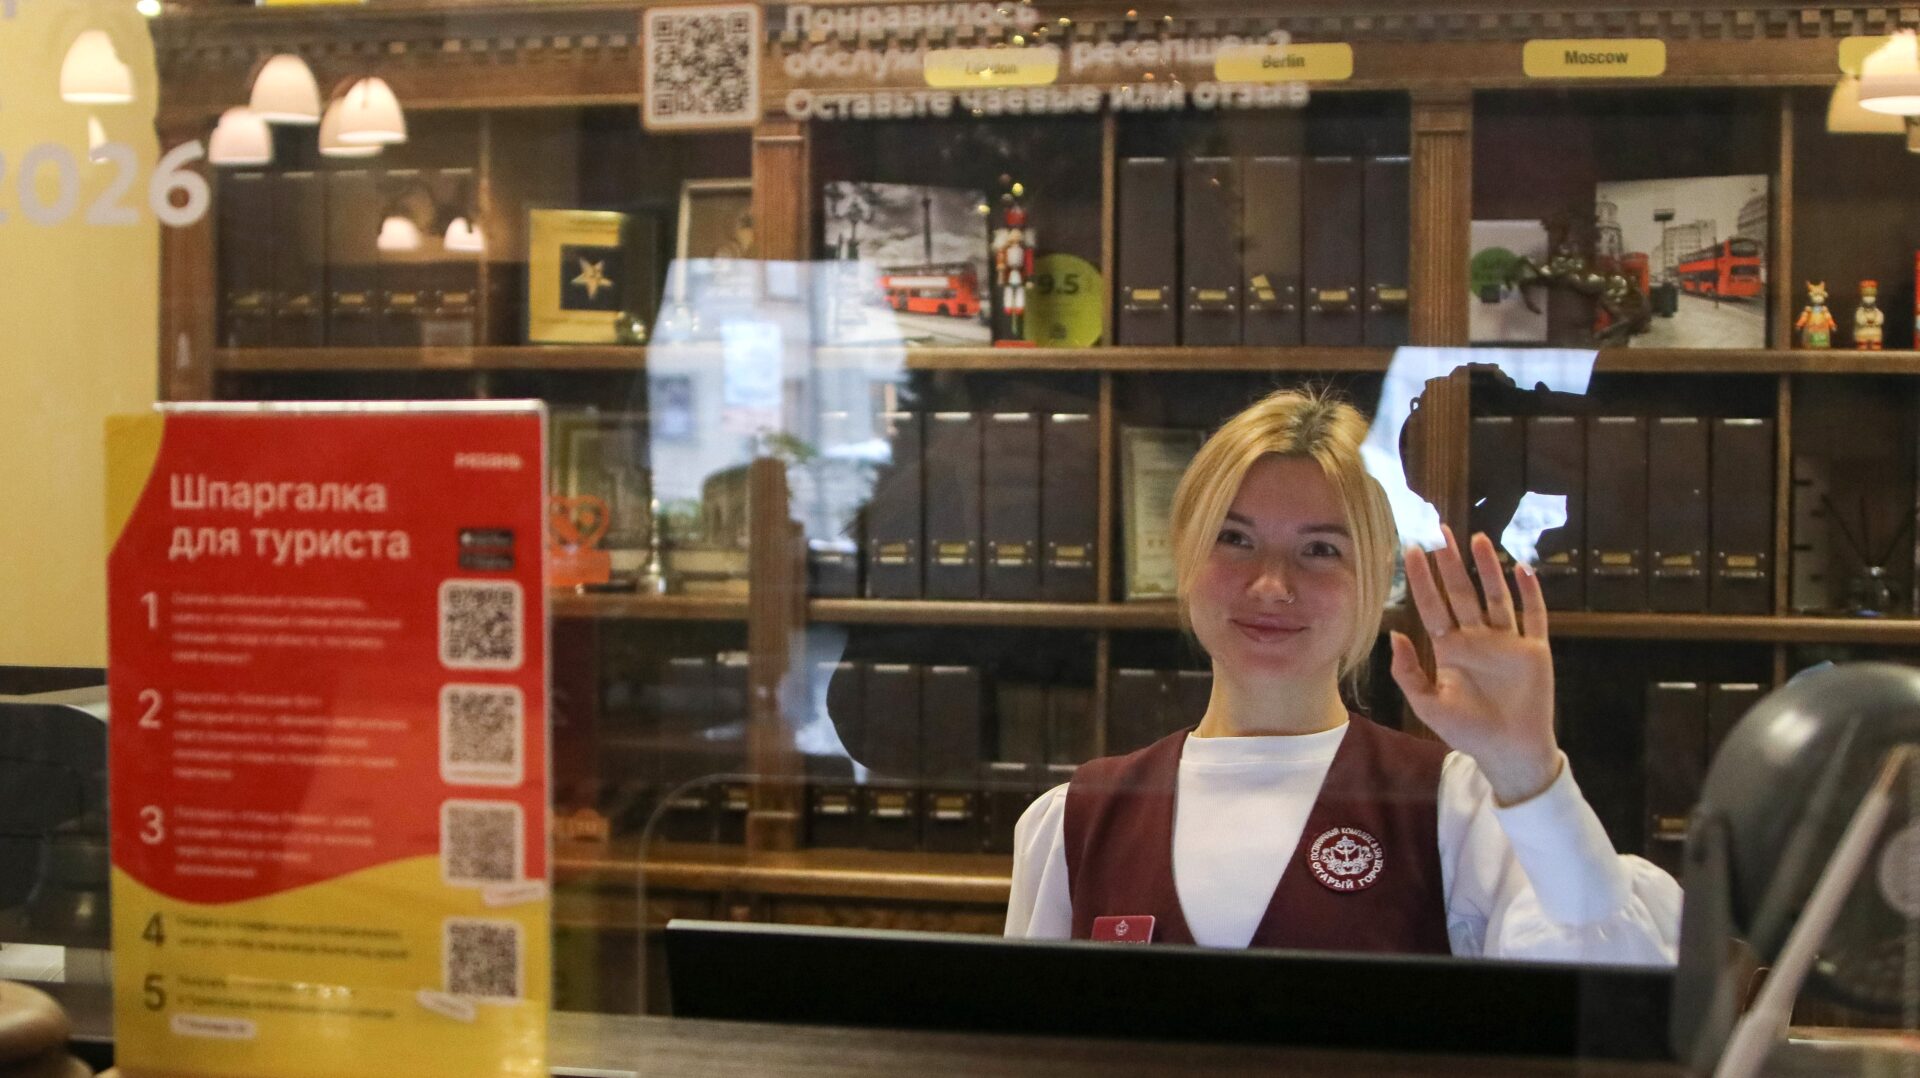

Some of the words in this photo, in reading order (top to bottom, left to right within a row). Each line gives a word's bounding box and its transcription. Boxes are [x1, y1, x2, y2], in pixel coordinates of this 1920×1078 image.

[785, 4, 1040, 37] Понравилось
[964, 61, 1018, 76] Lodon
[1564, 50, 1629, 65] Moscow
[784, 89, 954, 120] Оставьте
[958, 86, 1100, 119] чаевые
[1108, 82, 1187, 111] или
[1192, 80, 1311, 110] отзыв
[0, 138, 210, 228] 026
[169, 473, 389, 518] Шпаргалка
[168, 526, 241, 561] для
[250, 526, 411, 566] туриста
[141, 591, 158, 630] 1
[137, 688, 163, 729] 2
[138, 805, 165, 845] 3
[1312, 861, 1354, 889] СТАРЫЙ
[1357, 859, 1384, 887] ГОРОД
[141, 911, 166, 948] 4
[142, 973, 168, 1012] 5
